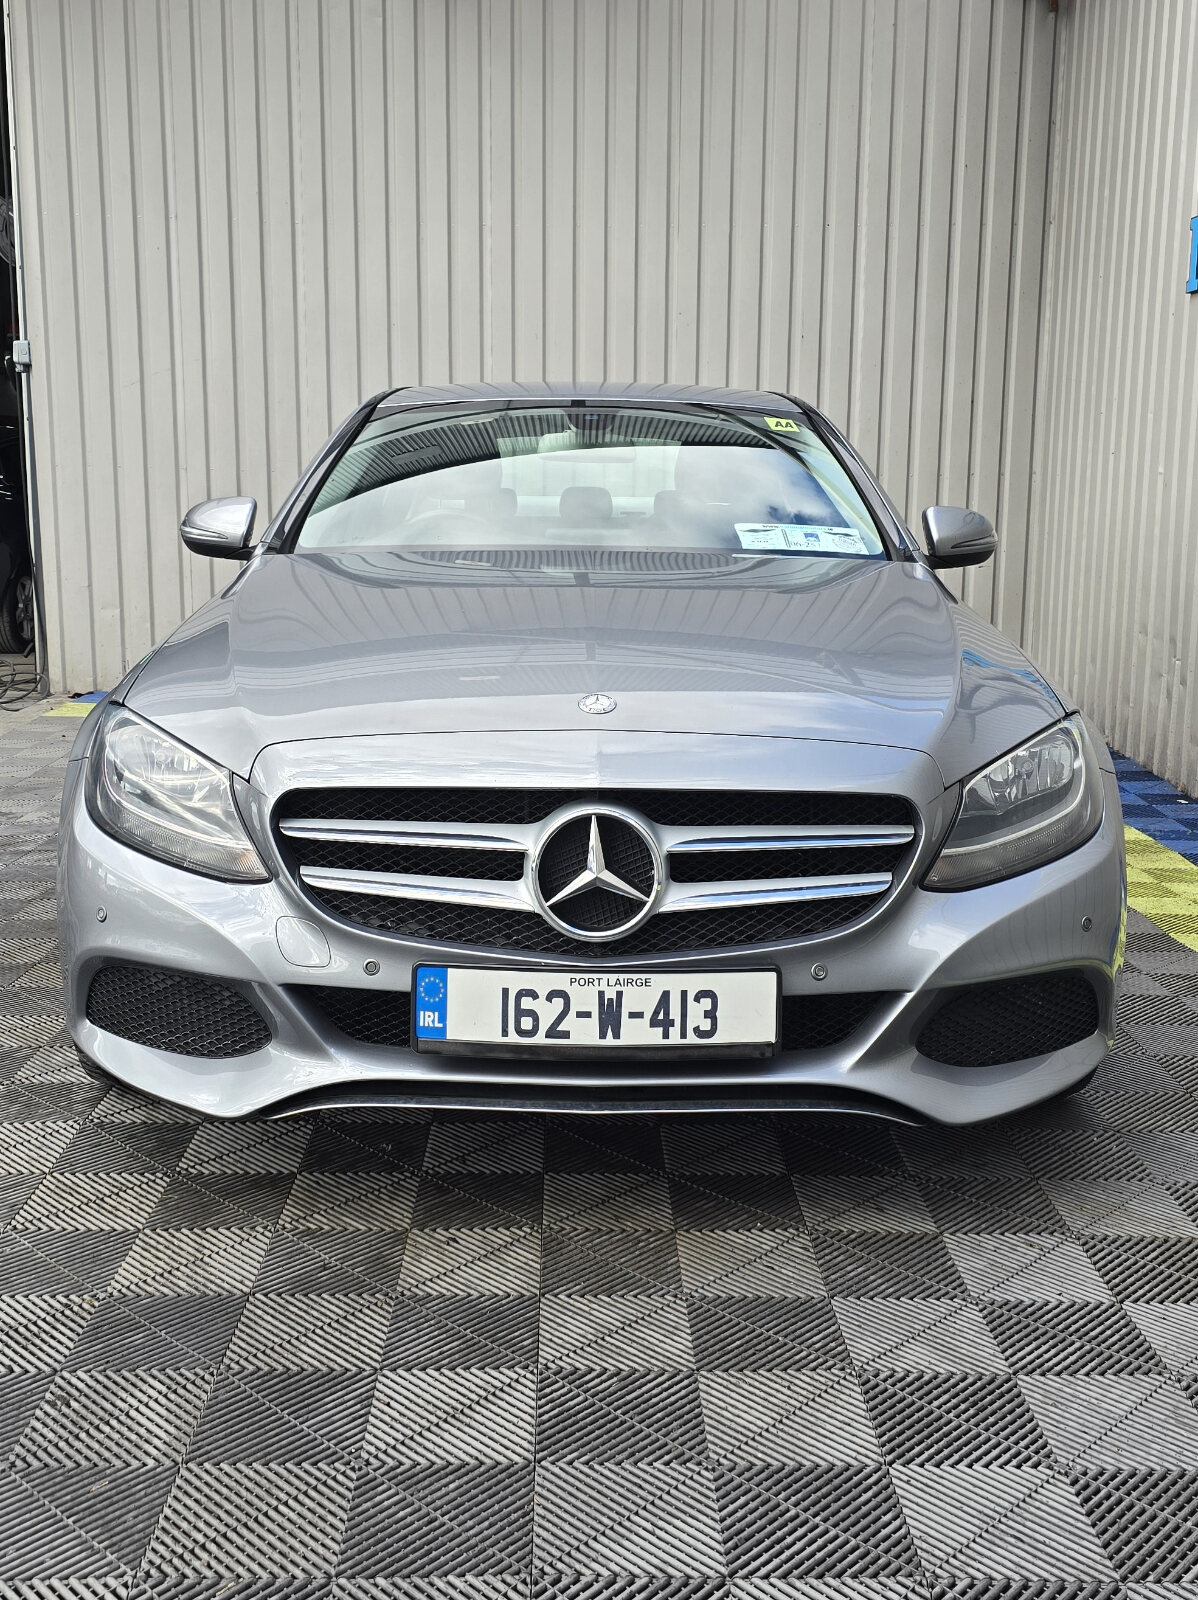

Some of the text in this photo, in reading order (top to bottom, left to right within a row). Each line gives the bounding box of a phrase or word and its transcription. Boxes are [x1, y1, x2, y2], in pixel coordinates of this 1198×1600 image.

[775, 420, 794, 428] AA
[570, 977, 603, 987] PORT
[419, 1011, 443, 1028] IRL
[501, 987, 719, 1040] 162-W-413
